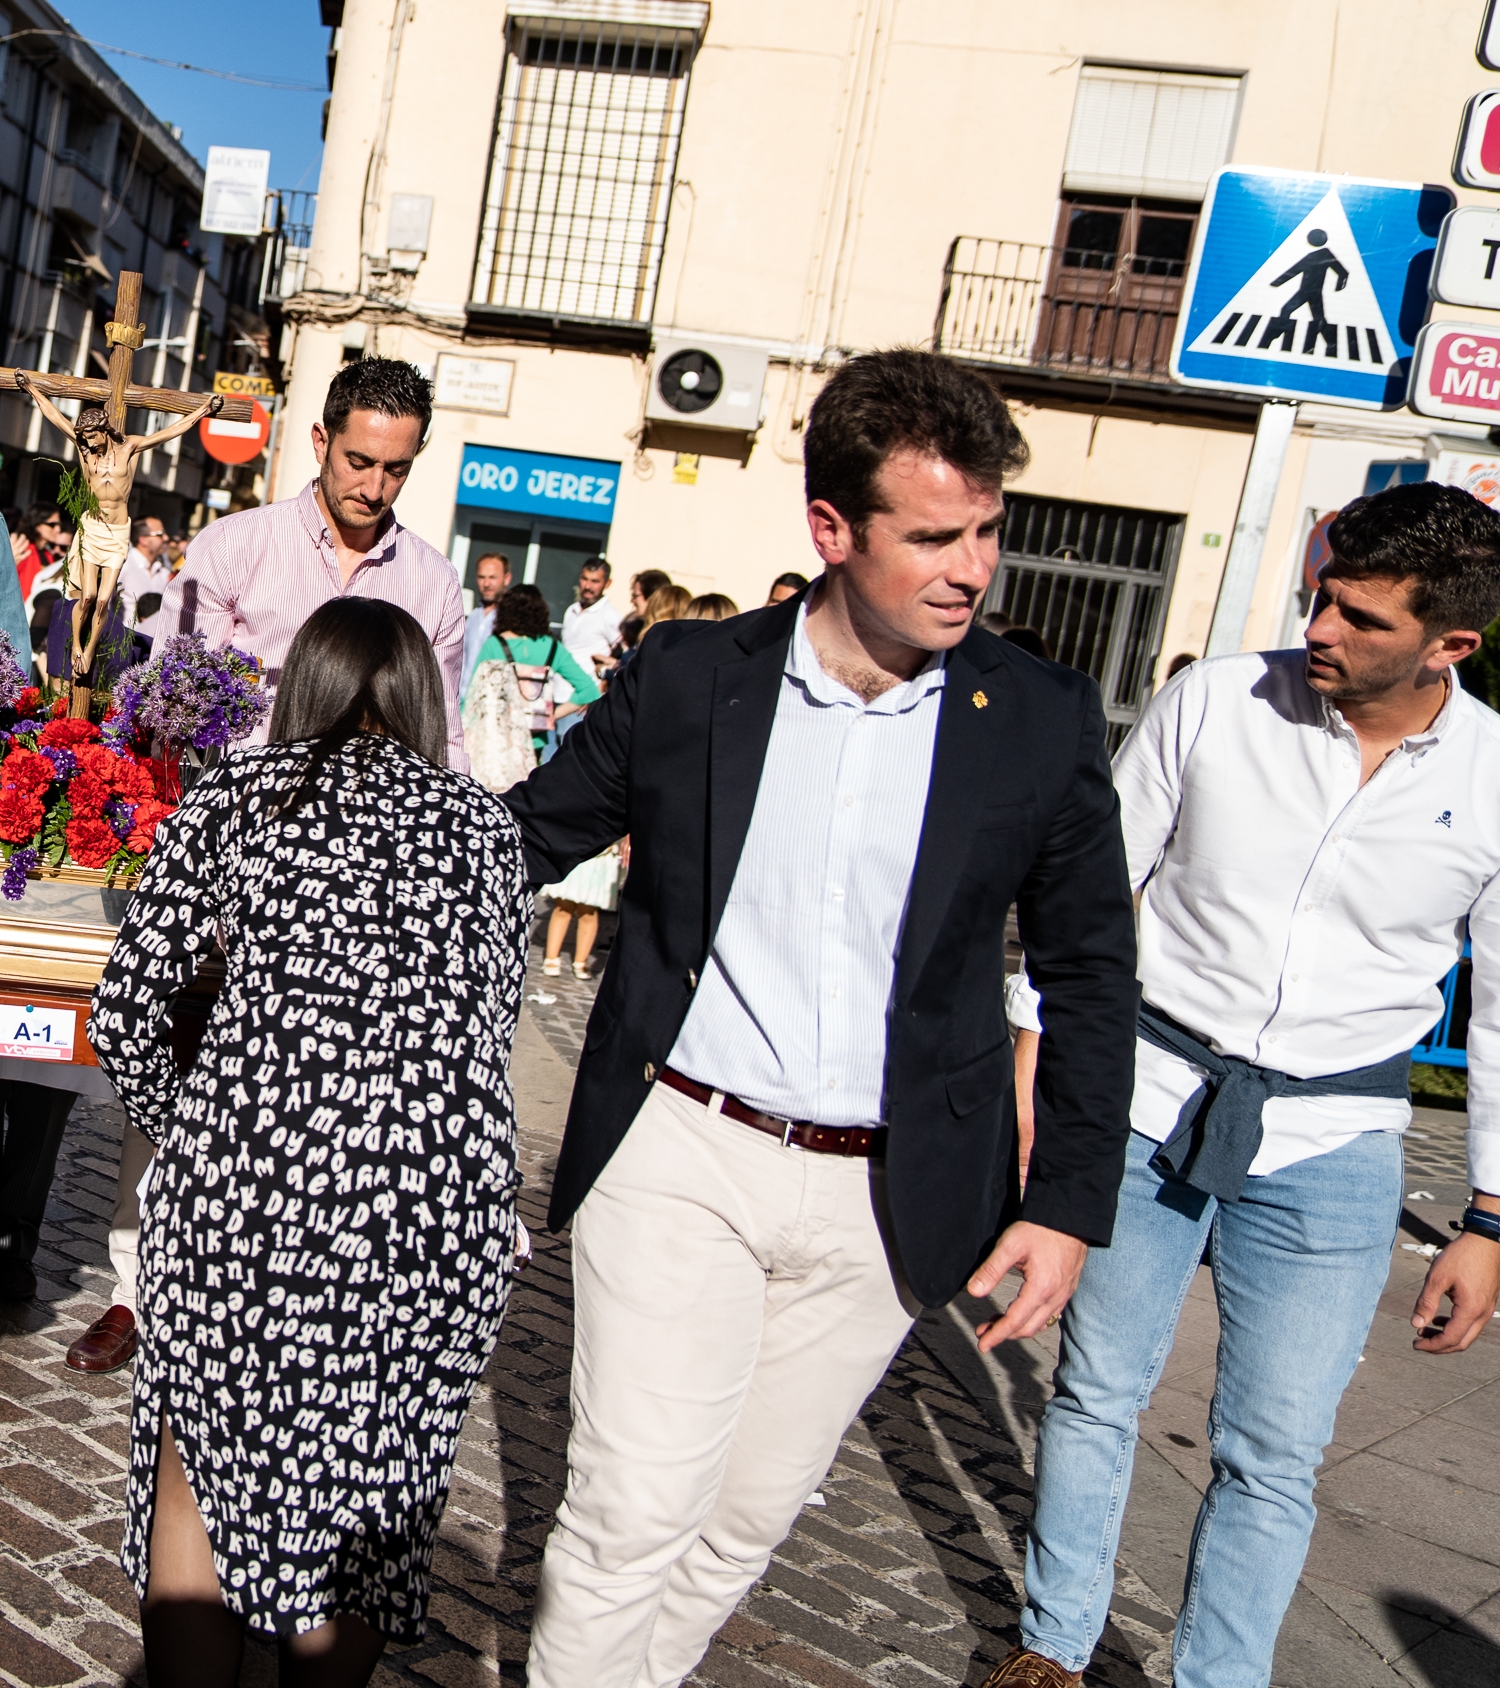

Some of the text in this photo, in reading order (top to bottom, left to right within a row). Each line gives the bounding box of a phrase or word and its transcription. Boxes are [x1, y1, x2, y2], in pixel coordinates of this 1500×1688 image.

[1448, 337, 1500, 369] Ca
[462, 461, 615, 505] ORO JEREZ
[13, 1022, 51, 1042] A-1
